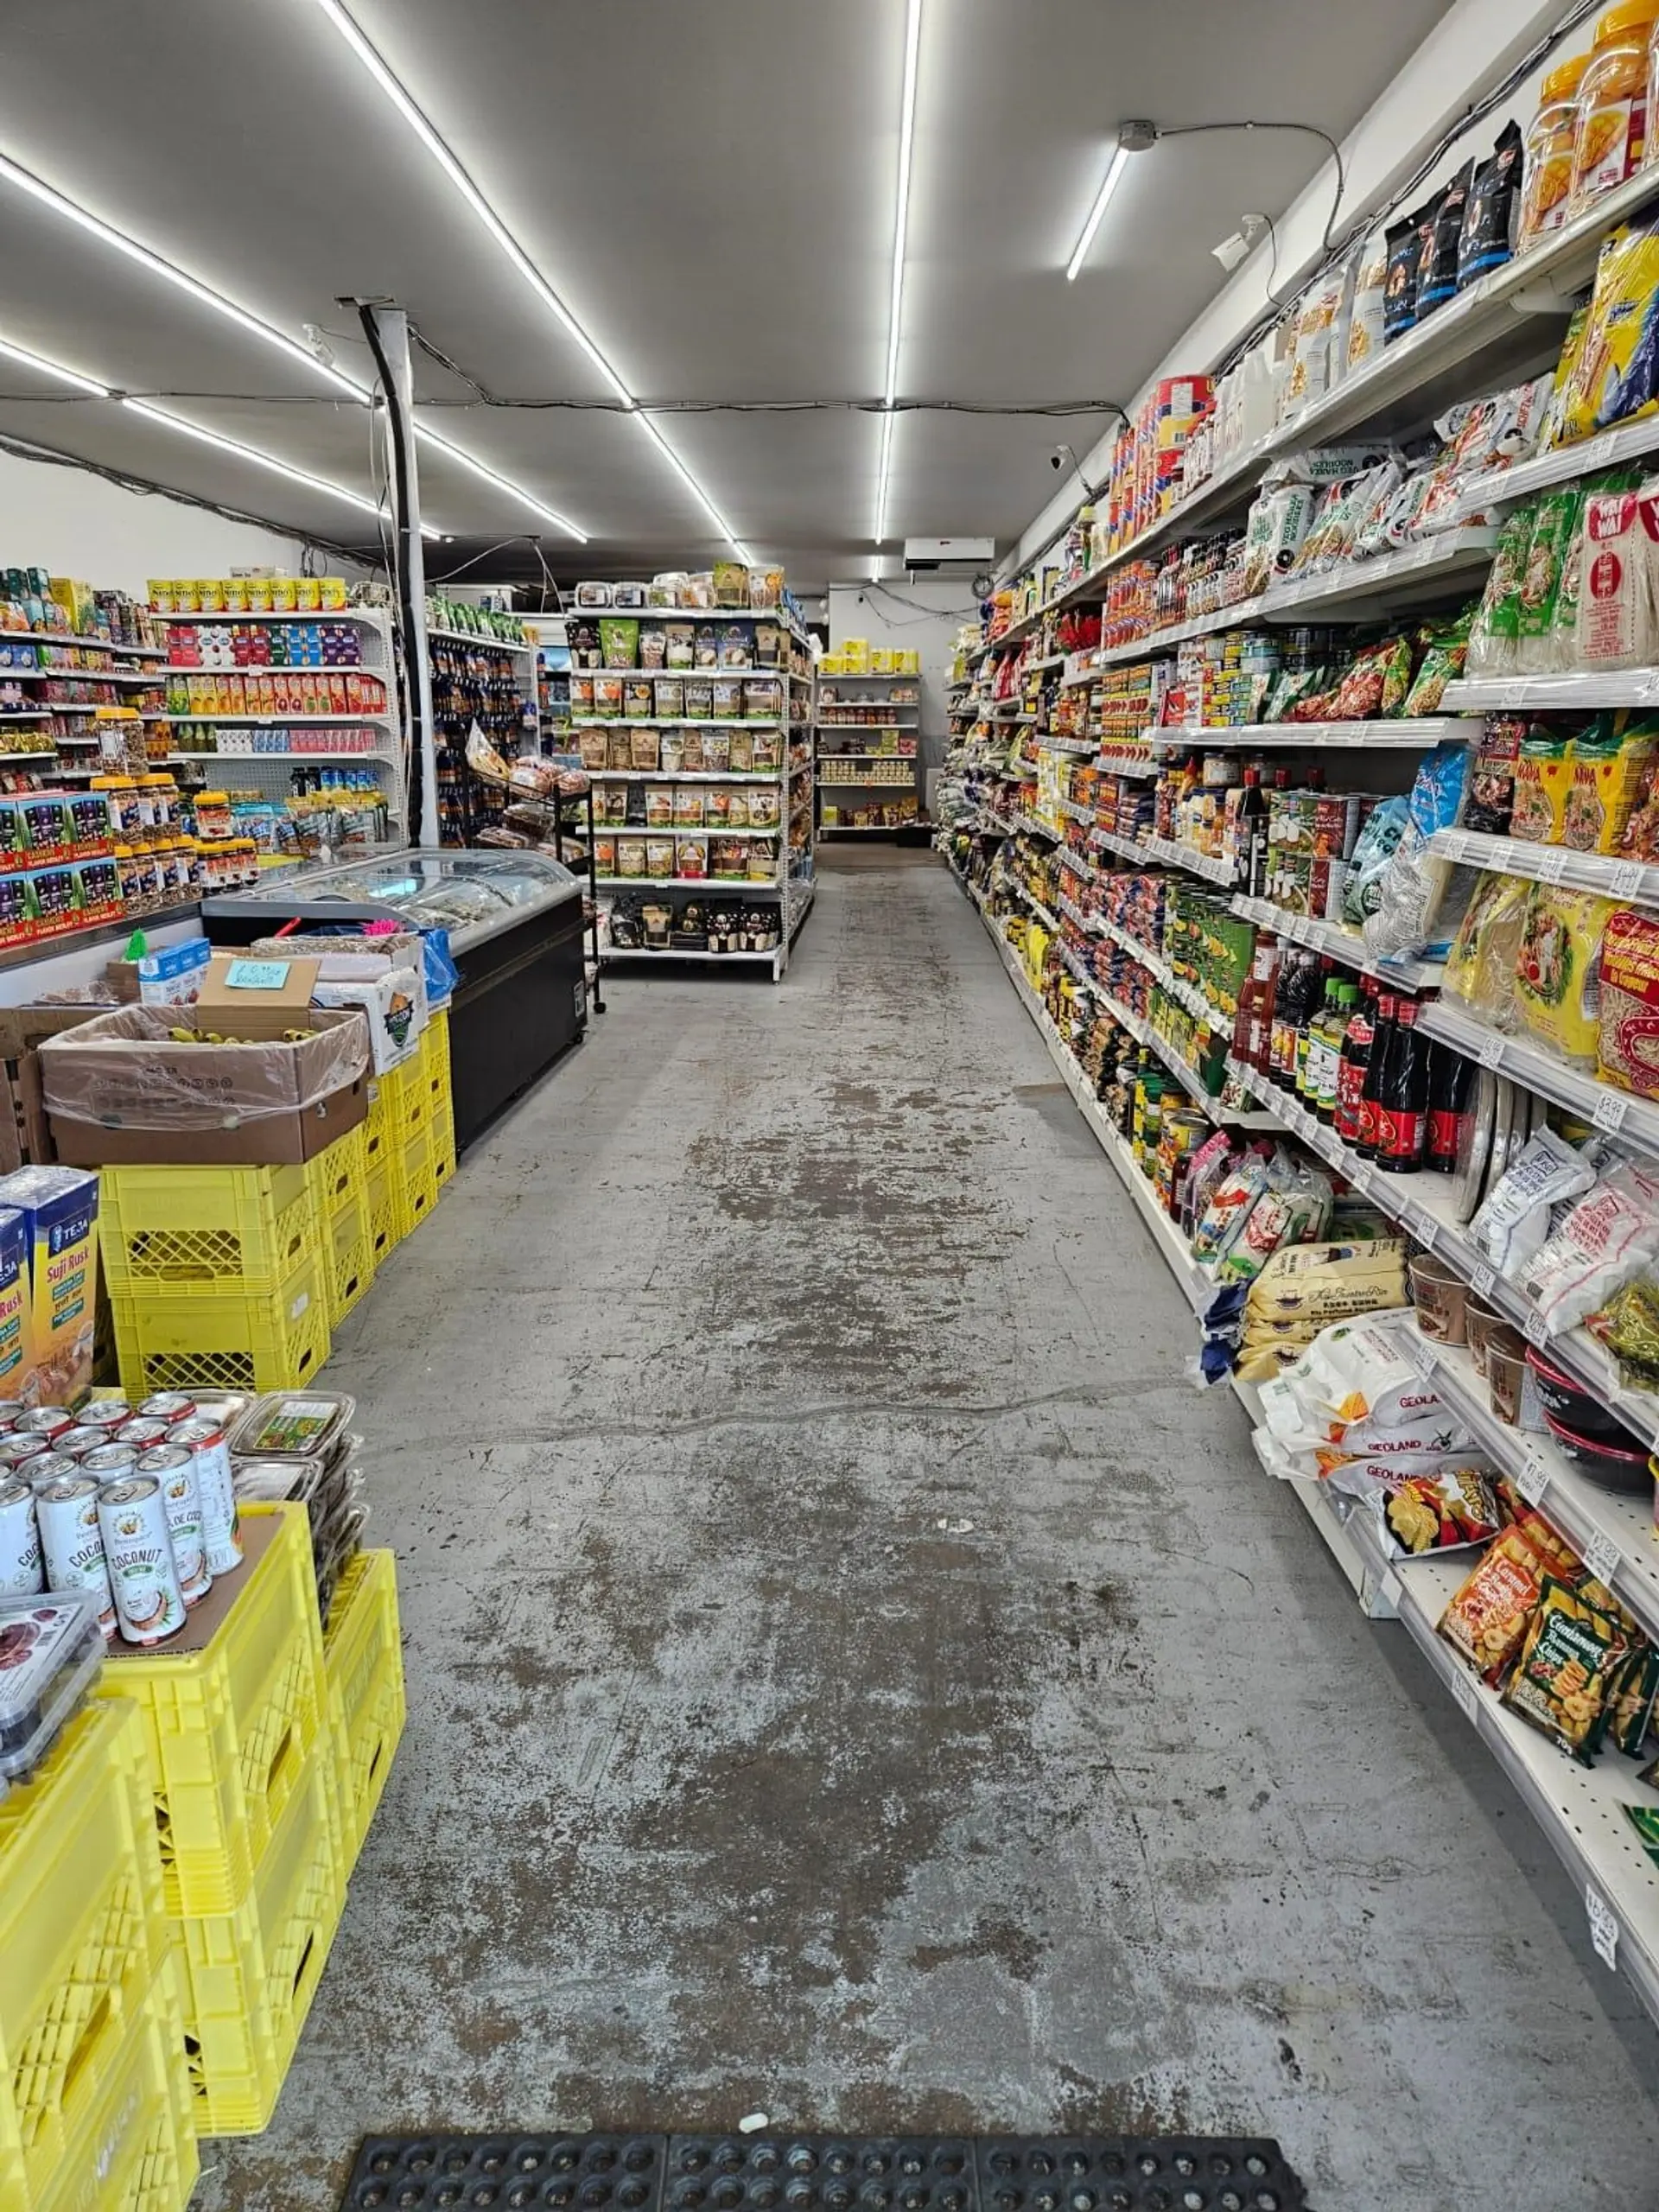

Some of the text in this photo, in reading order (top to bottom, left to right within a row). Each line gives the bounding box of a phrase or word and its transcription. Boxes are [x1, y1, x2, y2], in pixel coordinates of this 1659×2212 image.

[64, 1218, 87, 1241] TEJA
[48, 1246, 89, 1283] Suji Rusk
[1400, 1394, 1440, 1408] GEOLA
[1368, 1440, 1421, 1452] GEOLAND
[69, 1541, 104, 1568] COCO
[111, 1548, 162, 1571] COCONUT
